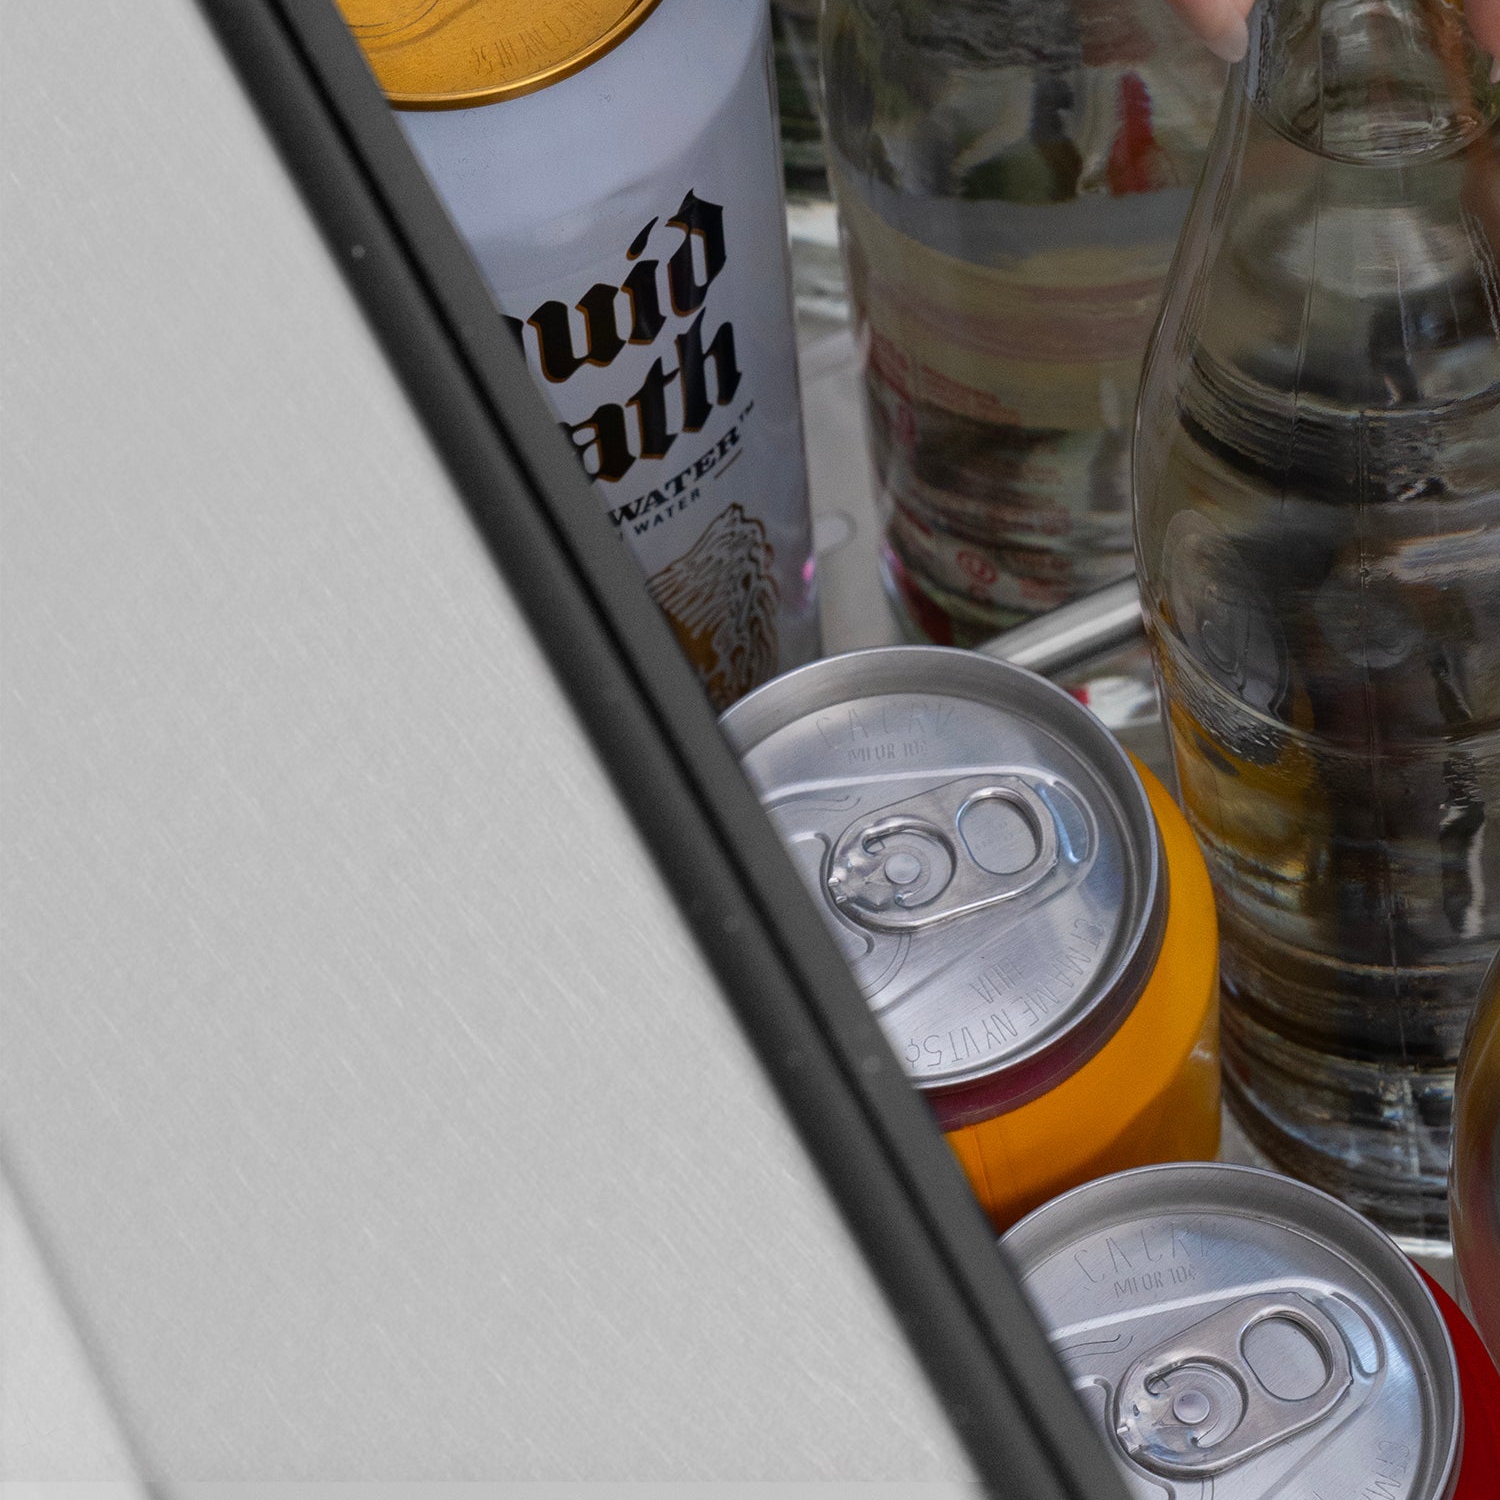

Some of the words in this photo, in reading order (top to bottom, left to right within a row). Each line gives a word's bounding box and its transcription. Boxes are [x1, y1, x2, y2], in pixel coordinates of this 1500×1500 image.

[503, 188, 727, 383] uid
[559, 307, 742, 483] ath
[607, 426, 740, 527] WATER
